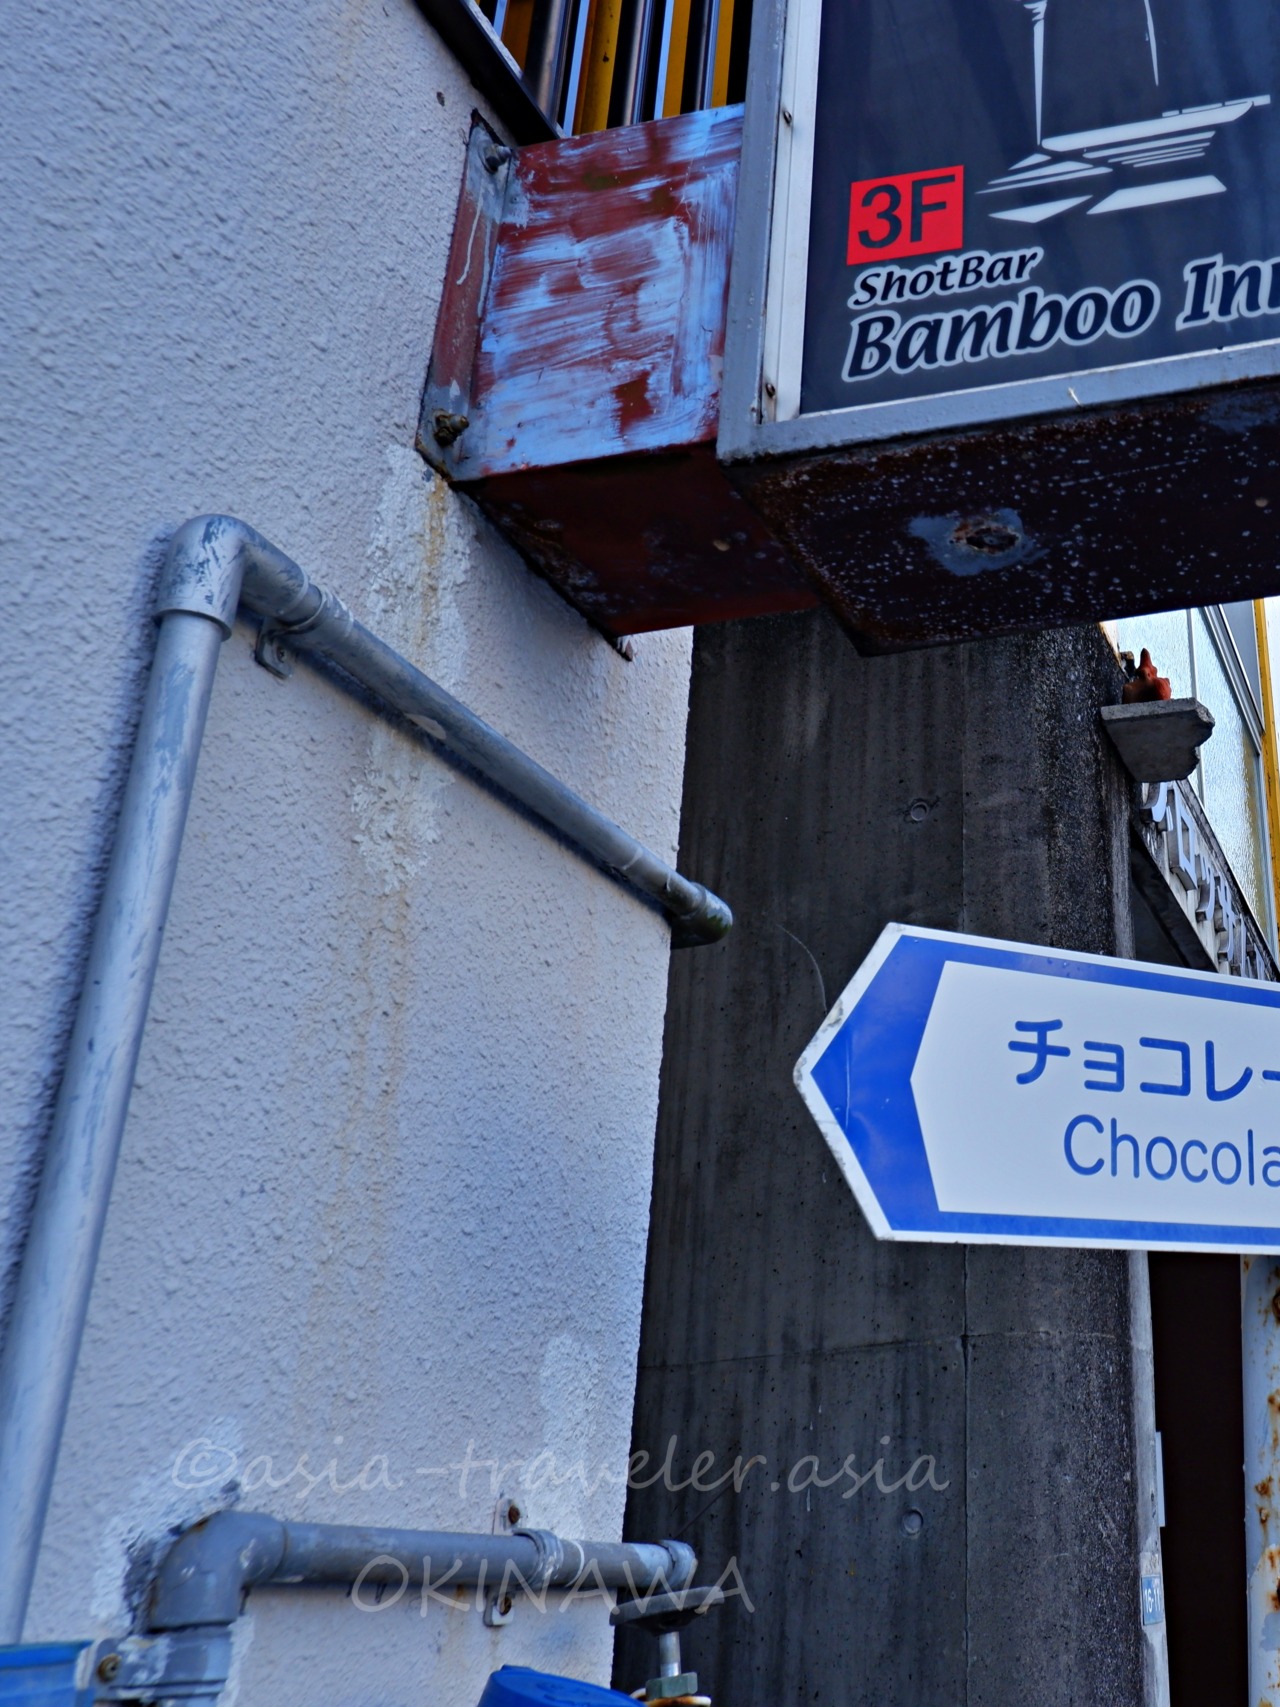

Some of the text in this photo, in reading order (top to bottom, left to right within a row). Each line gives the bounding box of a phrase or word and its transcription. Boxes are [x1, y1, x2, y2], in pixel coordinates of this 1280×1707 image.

[856, 174, 956, 249] 3F
[849, 248, 1044, 308] ShotBar
[842, 280, 1161, 382] Bamboo
